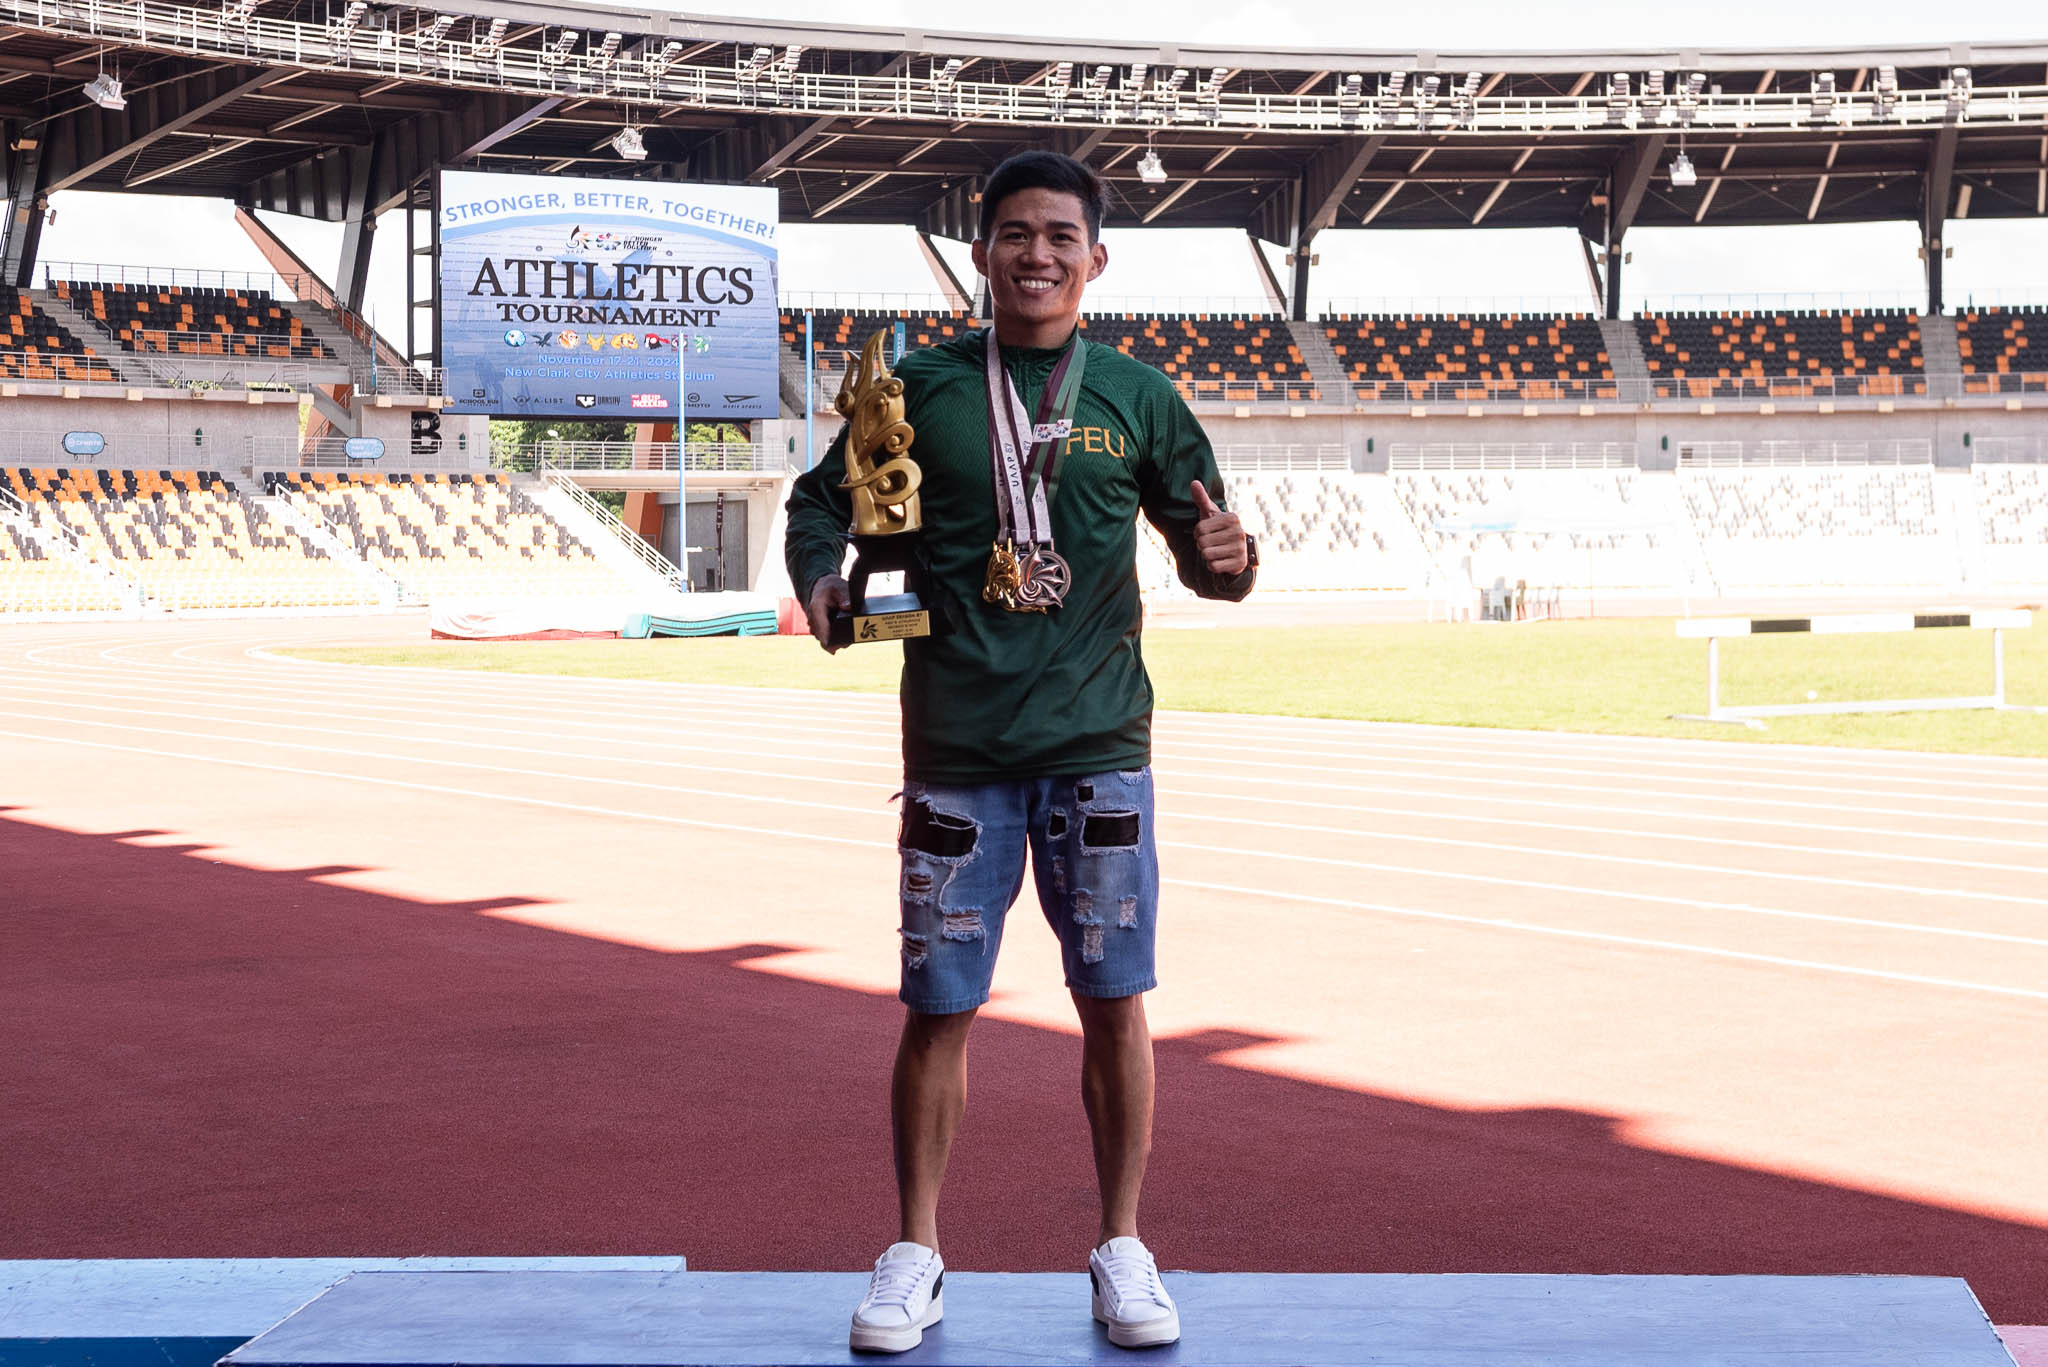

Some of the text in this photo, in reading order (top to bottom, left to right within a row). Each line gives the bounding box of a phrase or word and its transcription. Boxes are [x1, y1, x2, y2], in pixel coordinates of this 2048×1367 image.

[446, 192, 775, 239] STRONGER, BETTER, TOGETHER!
[467, 257, 754, 306] ATHLETICS
[496, 303, 720, 328] TOURNAMENT
[505, 367, 715, 381] New Clark City Athletics Stdium
[538, 354, 604, 366] November
[609, 355, 642, 368] 17-21,
[411, 411, 443, 455] B
[1064, 426, 1125, 458] FEU
